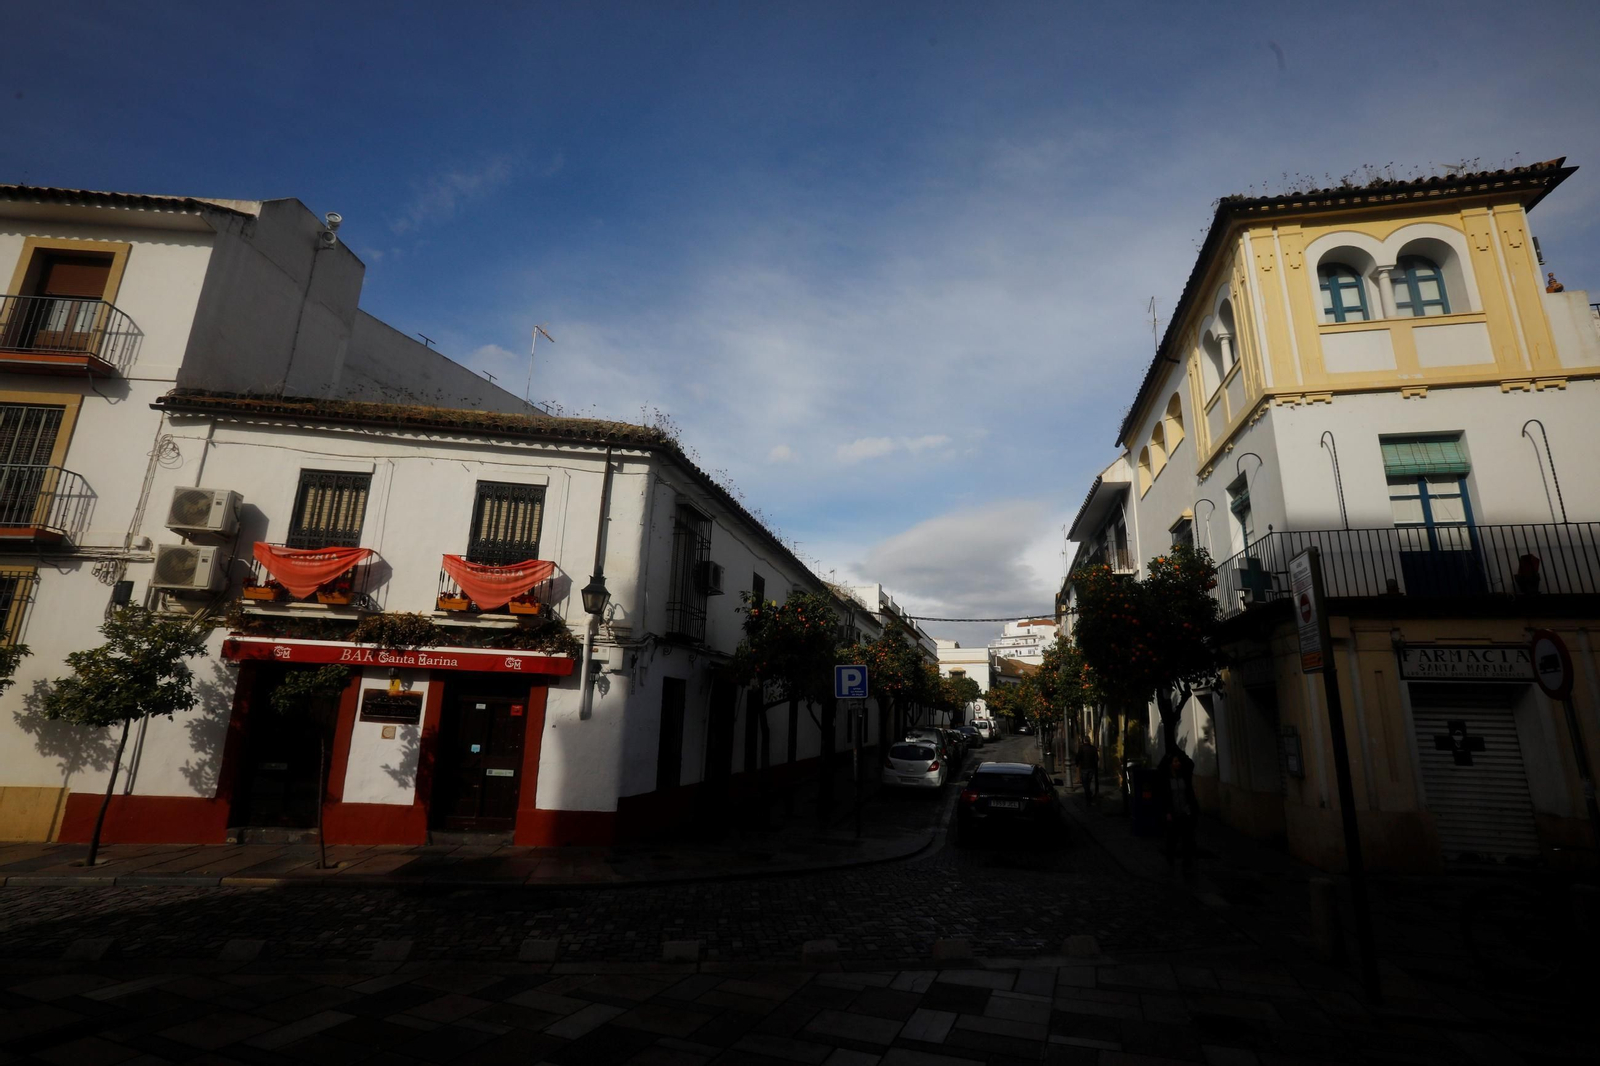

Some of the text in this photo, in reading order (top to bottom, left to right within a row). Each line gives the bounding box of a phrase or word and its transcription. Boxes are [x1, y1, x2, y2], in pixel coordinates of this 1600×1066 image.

[340, 648, 459, 667] BAR Santa Marina
[1403, 649, 1531, 663] FARMACIA
[1419, 663, 1516, 673] SANTA MARINA
[841, 668, 862, 695] P
